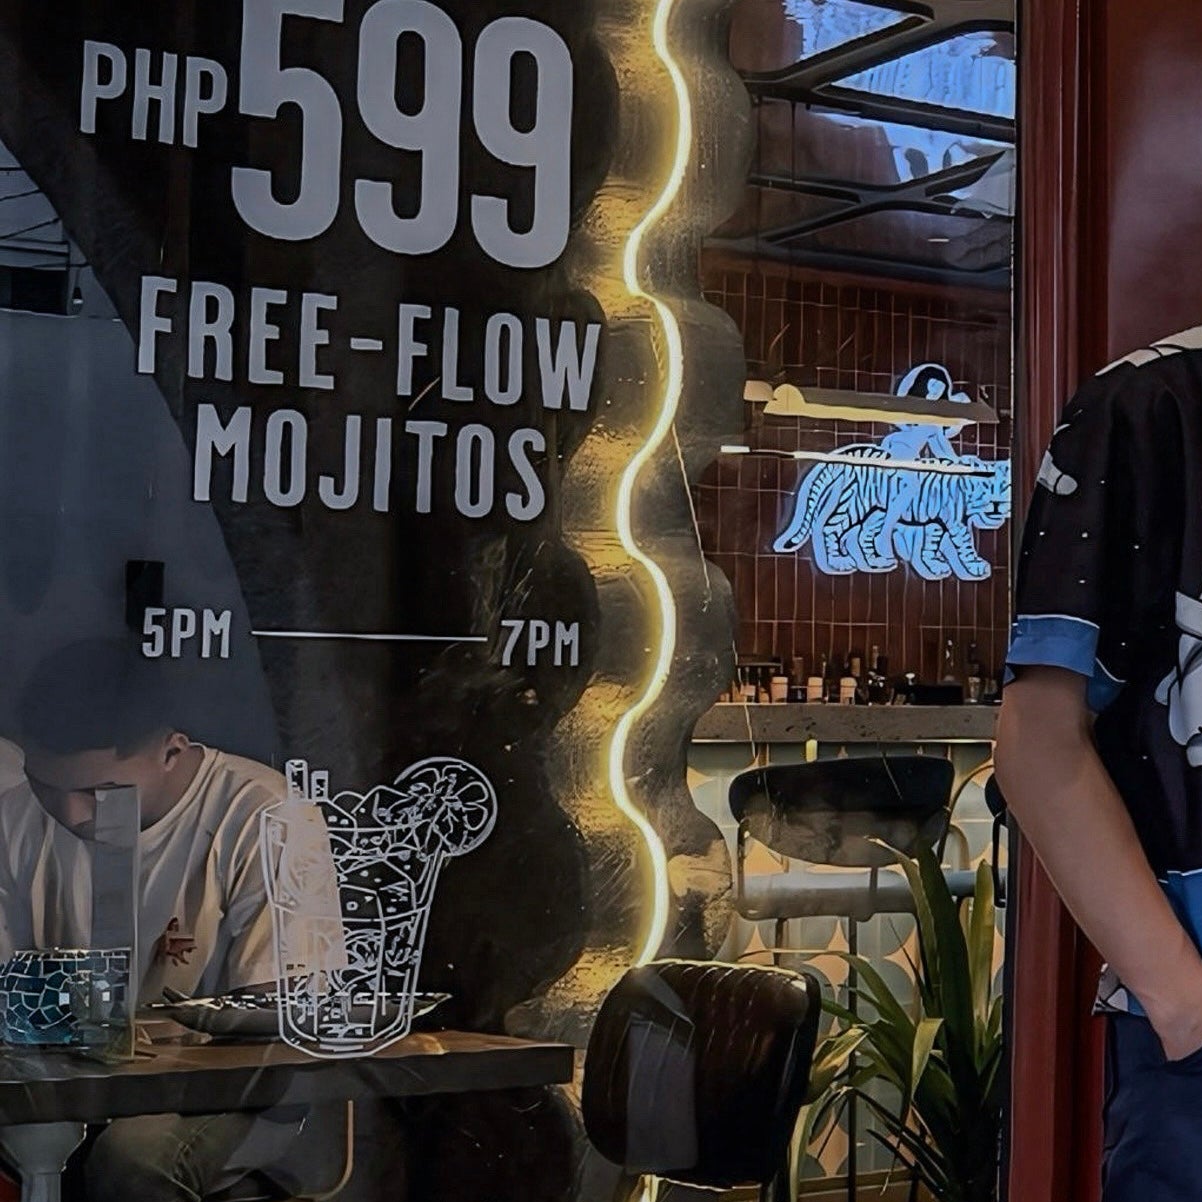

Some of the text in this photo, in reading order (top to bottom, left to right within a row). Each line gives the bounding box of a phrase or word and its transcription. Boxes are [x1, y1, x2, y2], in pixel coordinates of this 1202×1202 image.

[137, 275, 601, 412] FREE-FLOW
[193, 403, 546, 521] MOJITOS
[142, 607, 580, 667] 5PM 7PM
